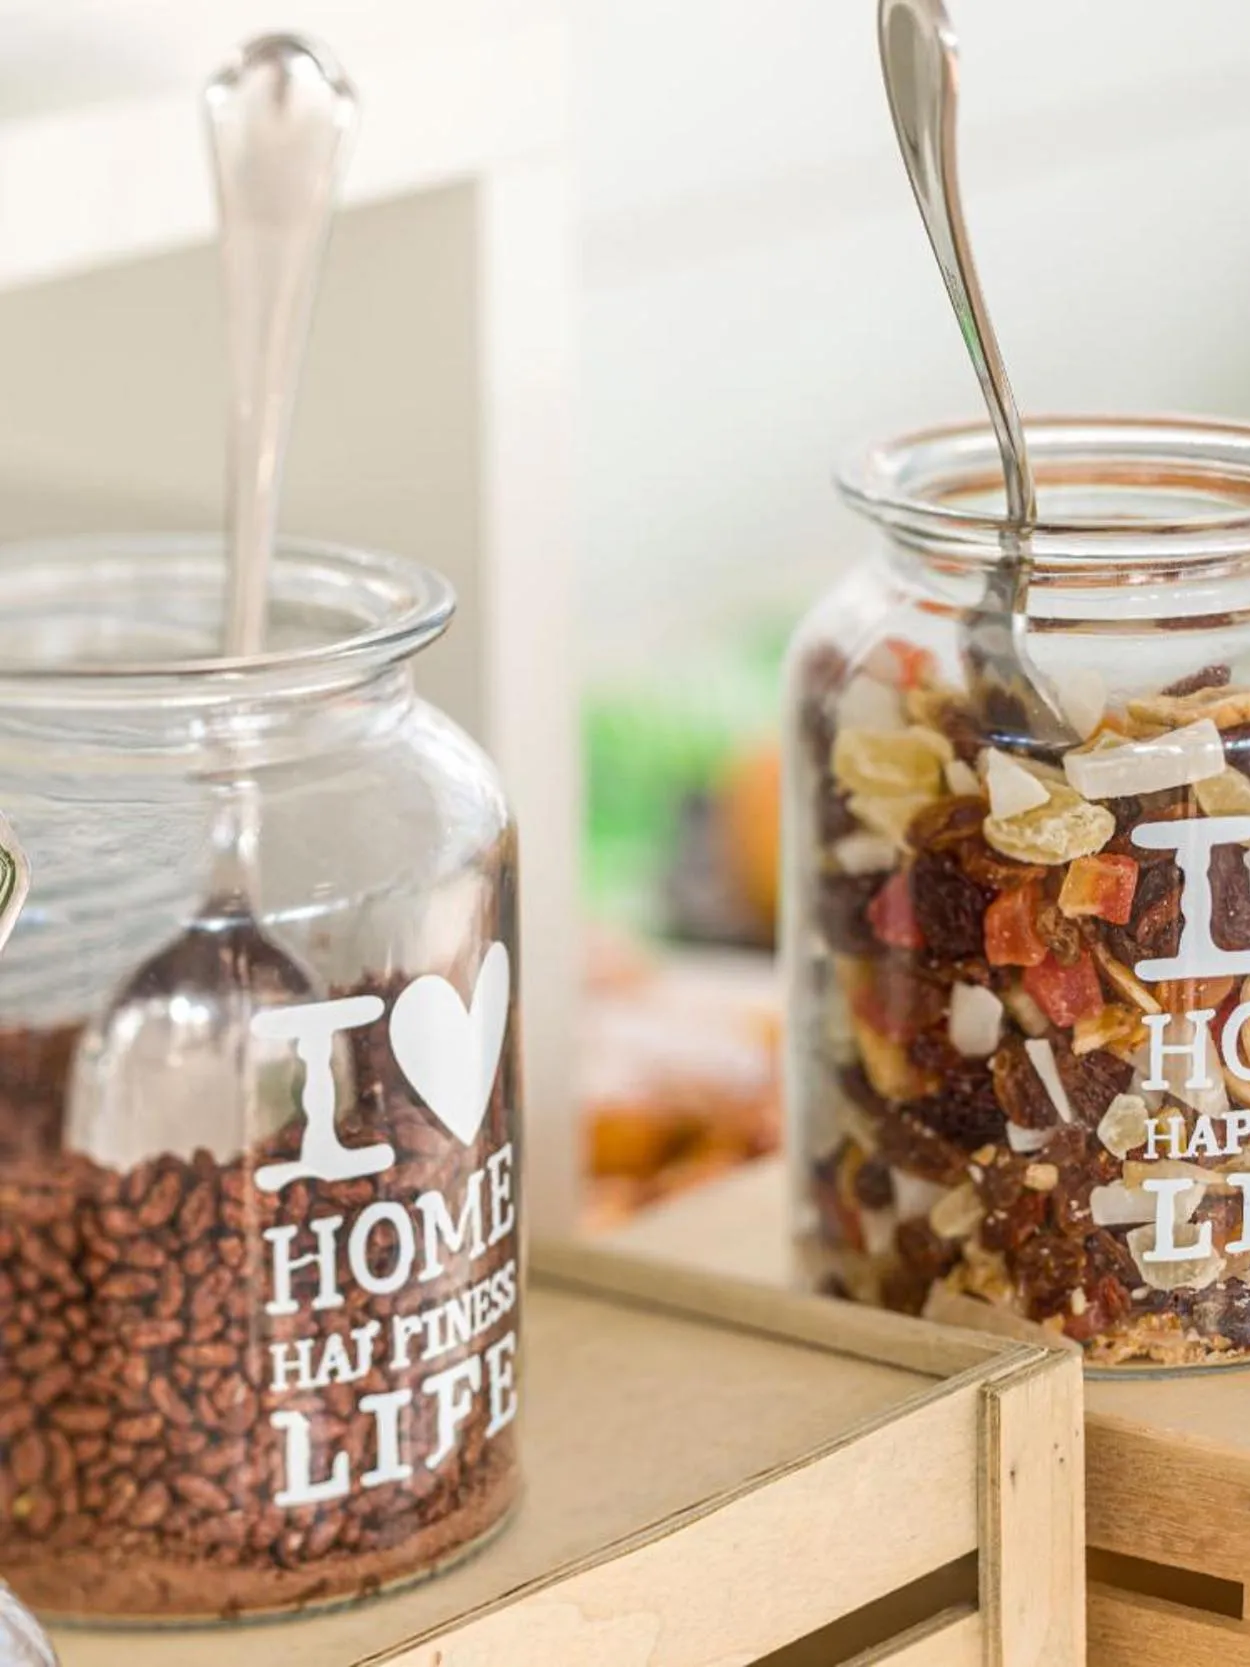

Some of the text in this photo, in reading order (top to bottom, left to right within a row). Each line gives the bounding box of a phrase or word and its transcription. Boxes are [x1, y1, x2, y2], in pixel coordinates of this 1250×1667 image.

[251, 995, 395, 1192] I
[264, 1143, 514, 1315] HOME
[271, 1333, 518, 1507] LIFE
